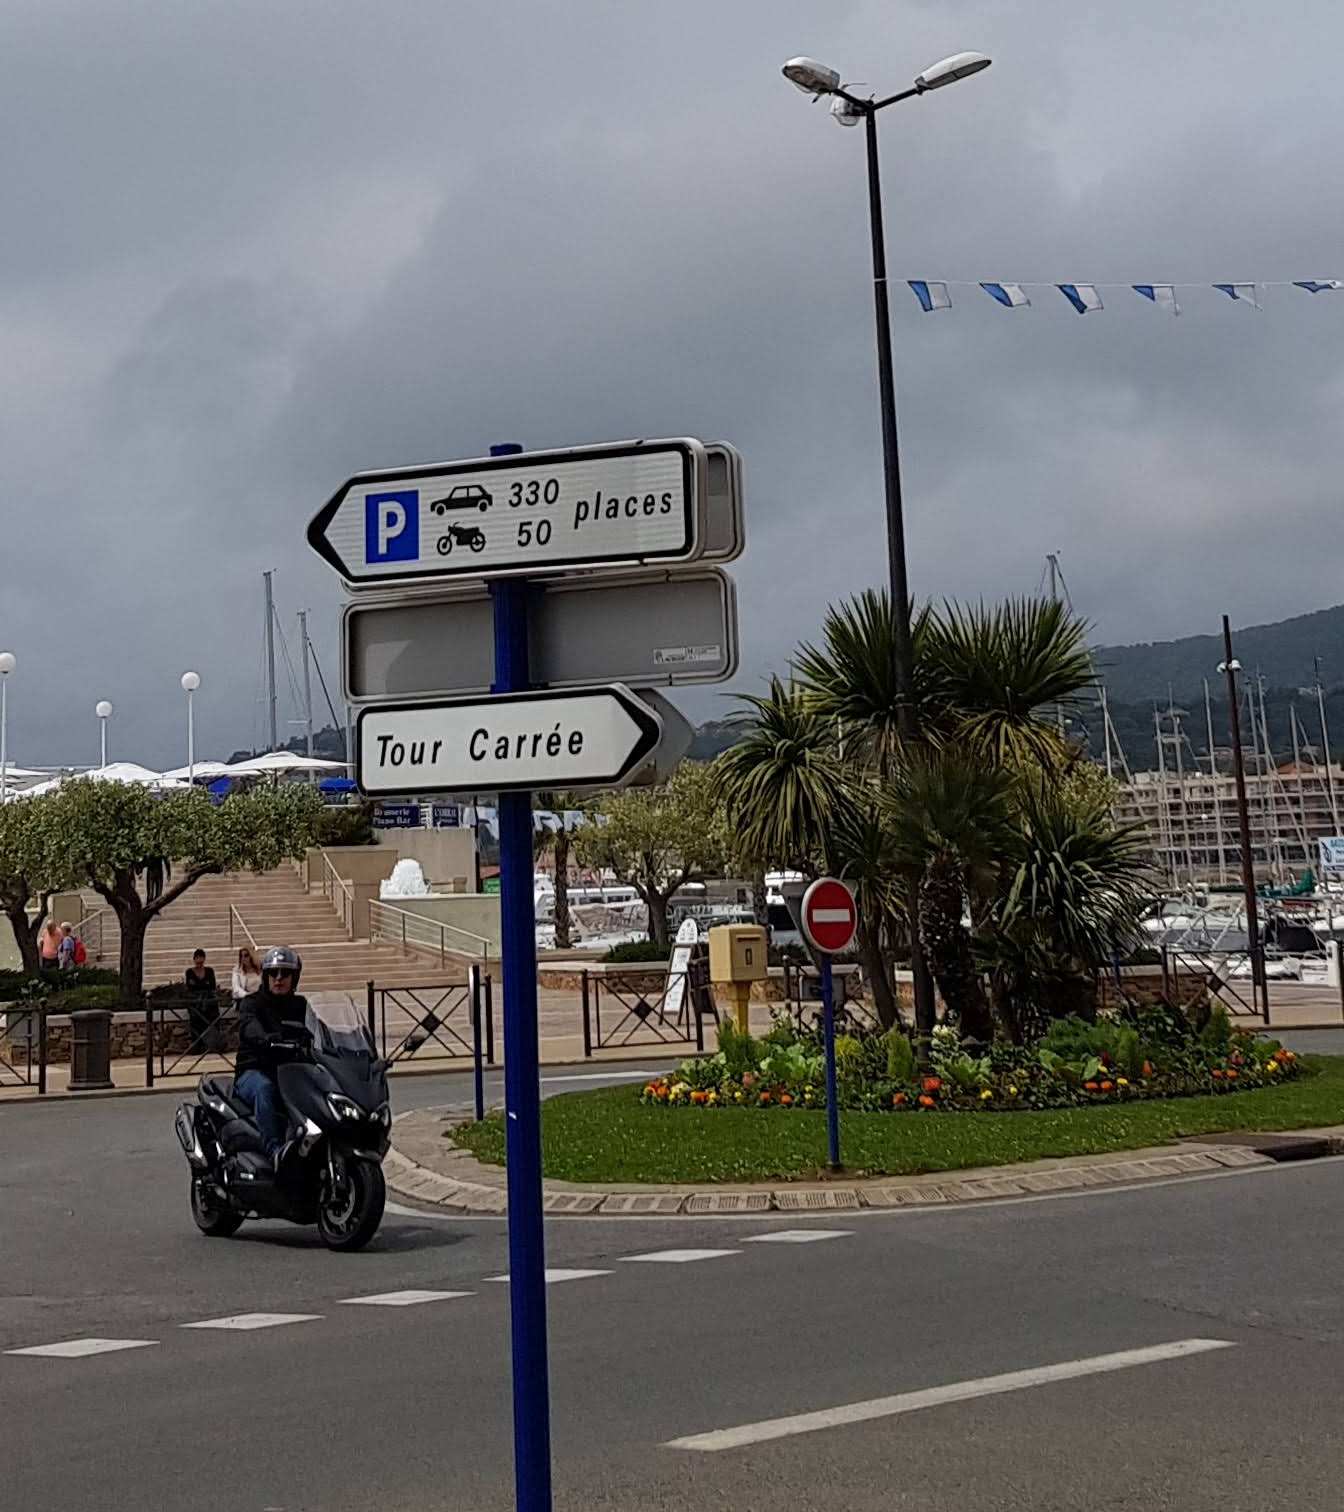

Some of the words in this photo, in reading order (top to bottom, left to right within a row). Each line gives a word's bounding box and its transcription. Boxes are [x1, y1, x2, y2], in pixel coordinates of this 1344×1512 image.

[508, 478, 560, 508] 330
[573, 491, 672, 530] places
[377, 500, 406, 555] P
[516, 519, 552, 547] 50
[376, 734, 443, 767] Tour
[468, 722, 584, 762] Carrée
